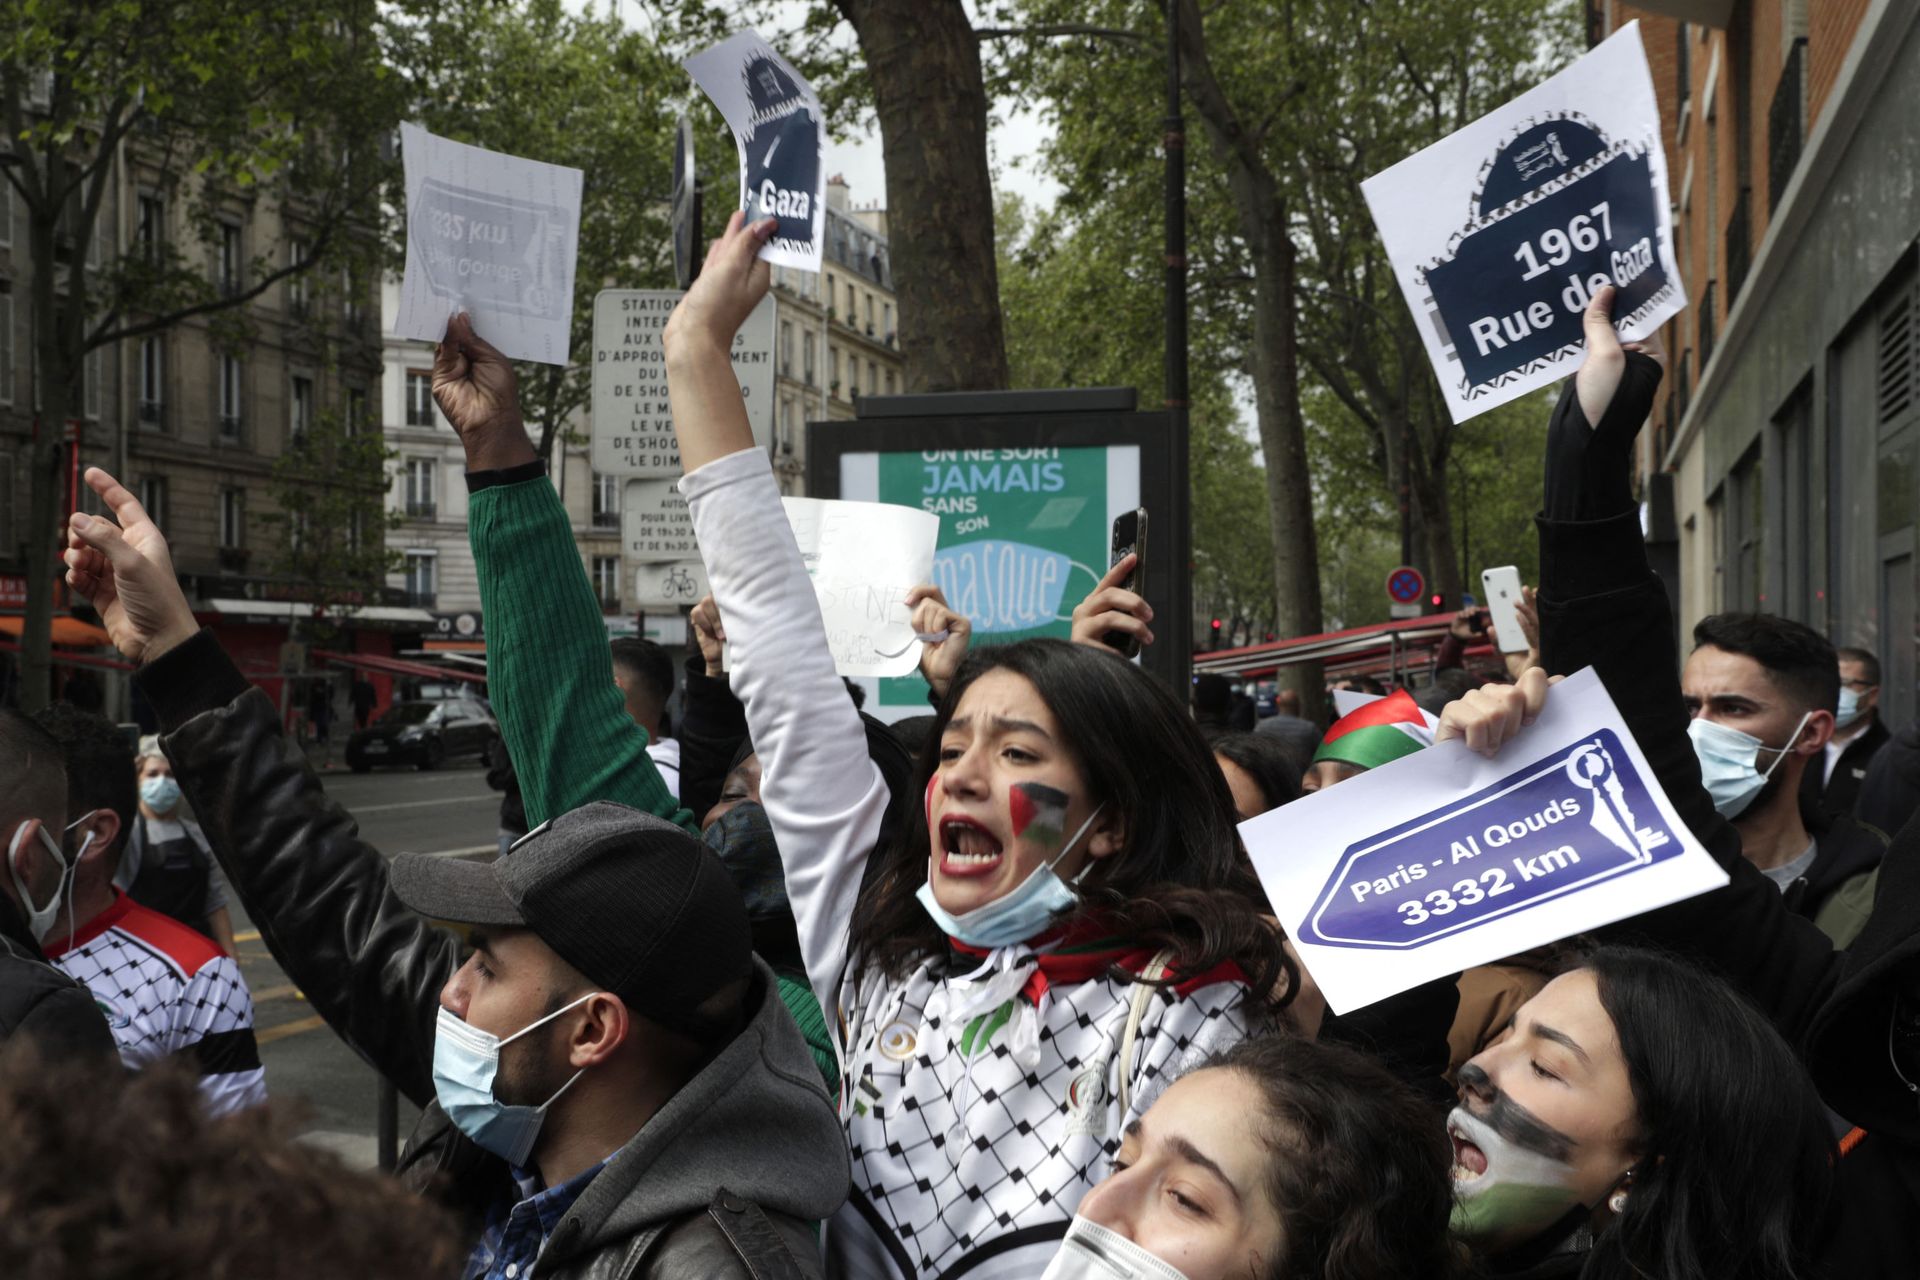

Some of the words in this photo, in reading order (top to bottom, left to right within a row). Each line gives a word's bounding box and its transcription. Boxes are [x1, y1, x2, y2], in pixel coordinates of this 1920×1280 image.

[760, 178, 809, 220] Gaza
[1514, 200, 1613, 281] 1967
[1469, 299, 1555, 357] Rue
[1562, 271, 1614, 314] de
[1611, 236, 1655, 288] Gaza
[622, 299, 681, 310] STATIO
[624, 334, 652, 344] AUX
[640, 368, 658, 379] DU
[614, 385, 632, 397] DE
[635, 403, 651, 414] LE
[632, 421, 647, 432] LE
[614, 437, 631, 448] DE
[630, 455, 646, 466] LE
[922, 449, 957, 462] ON
[963, 449, 995, 461] NE
[1001, 448, 1059, 460] SORT
[922, 462, 1065, 494] JAMAIS
[922, 497, 977, 513] SANS
[955, 515, 989, 535] SON
[1350, 863, 1428, 903] Paris
[1432, 859, 1443, 867] -
[1450, 835, 1481, 865] Al
[1483, 798, 1581, 847] Qouds
[1397, 868, 1515, 925] 3332
[1512, 845, 1581, 882] km
